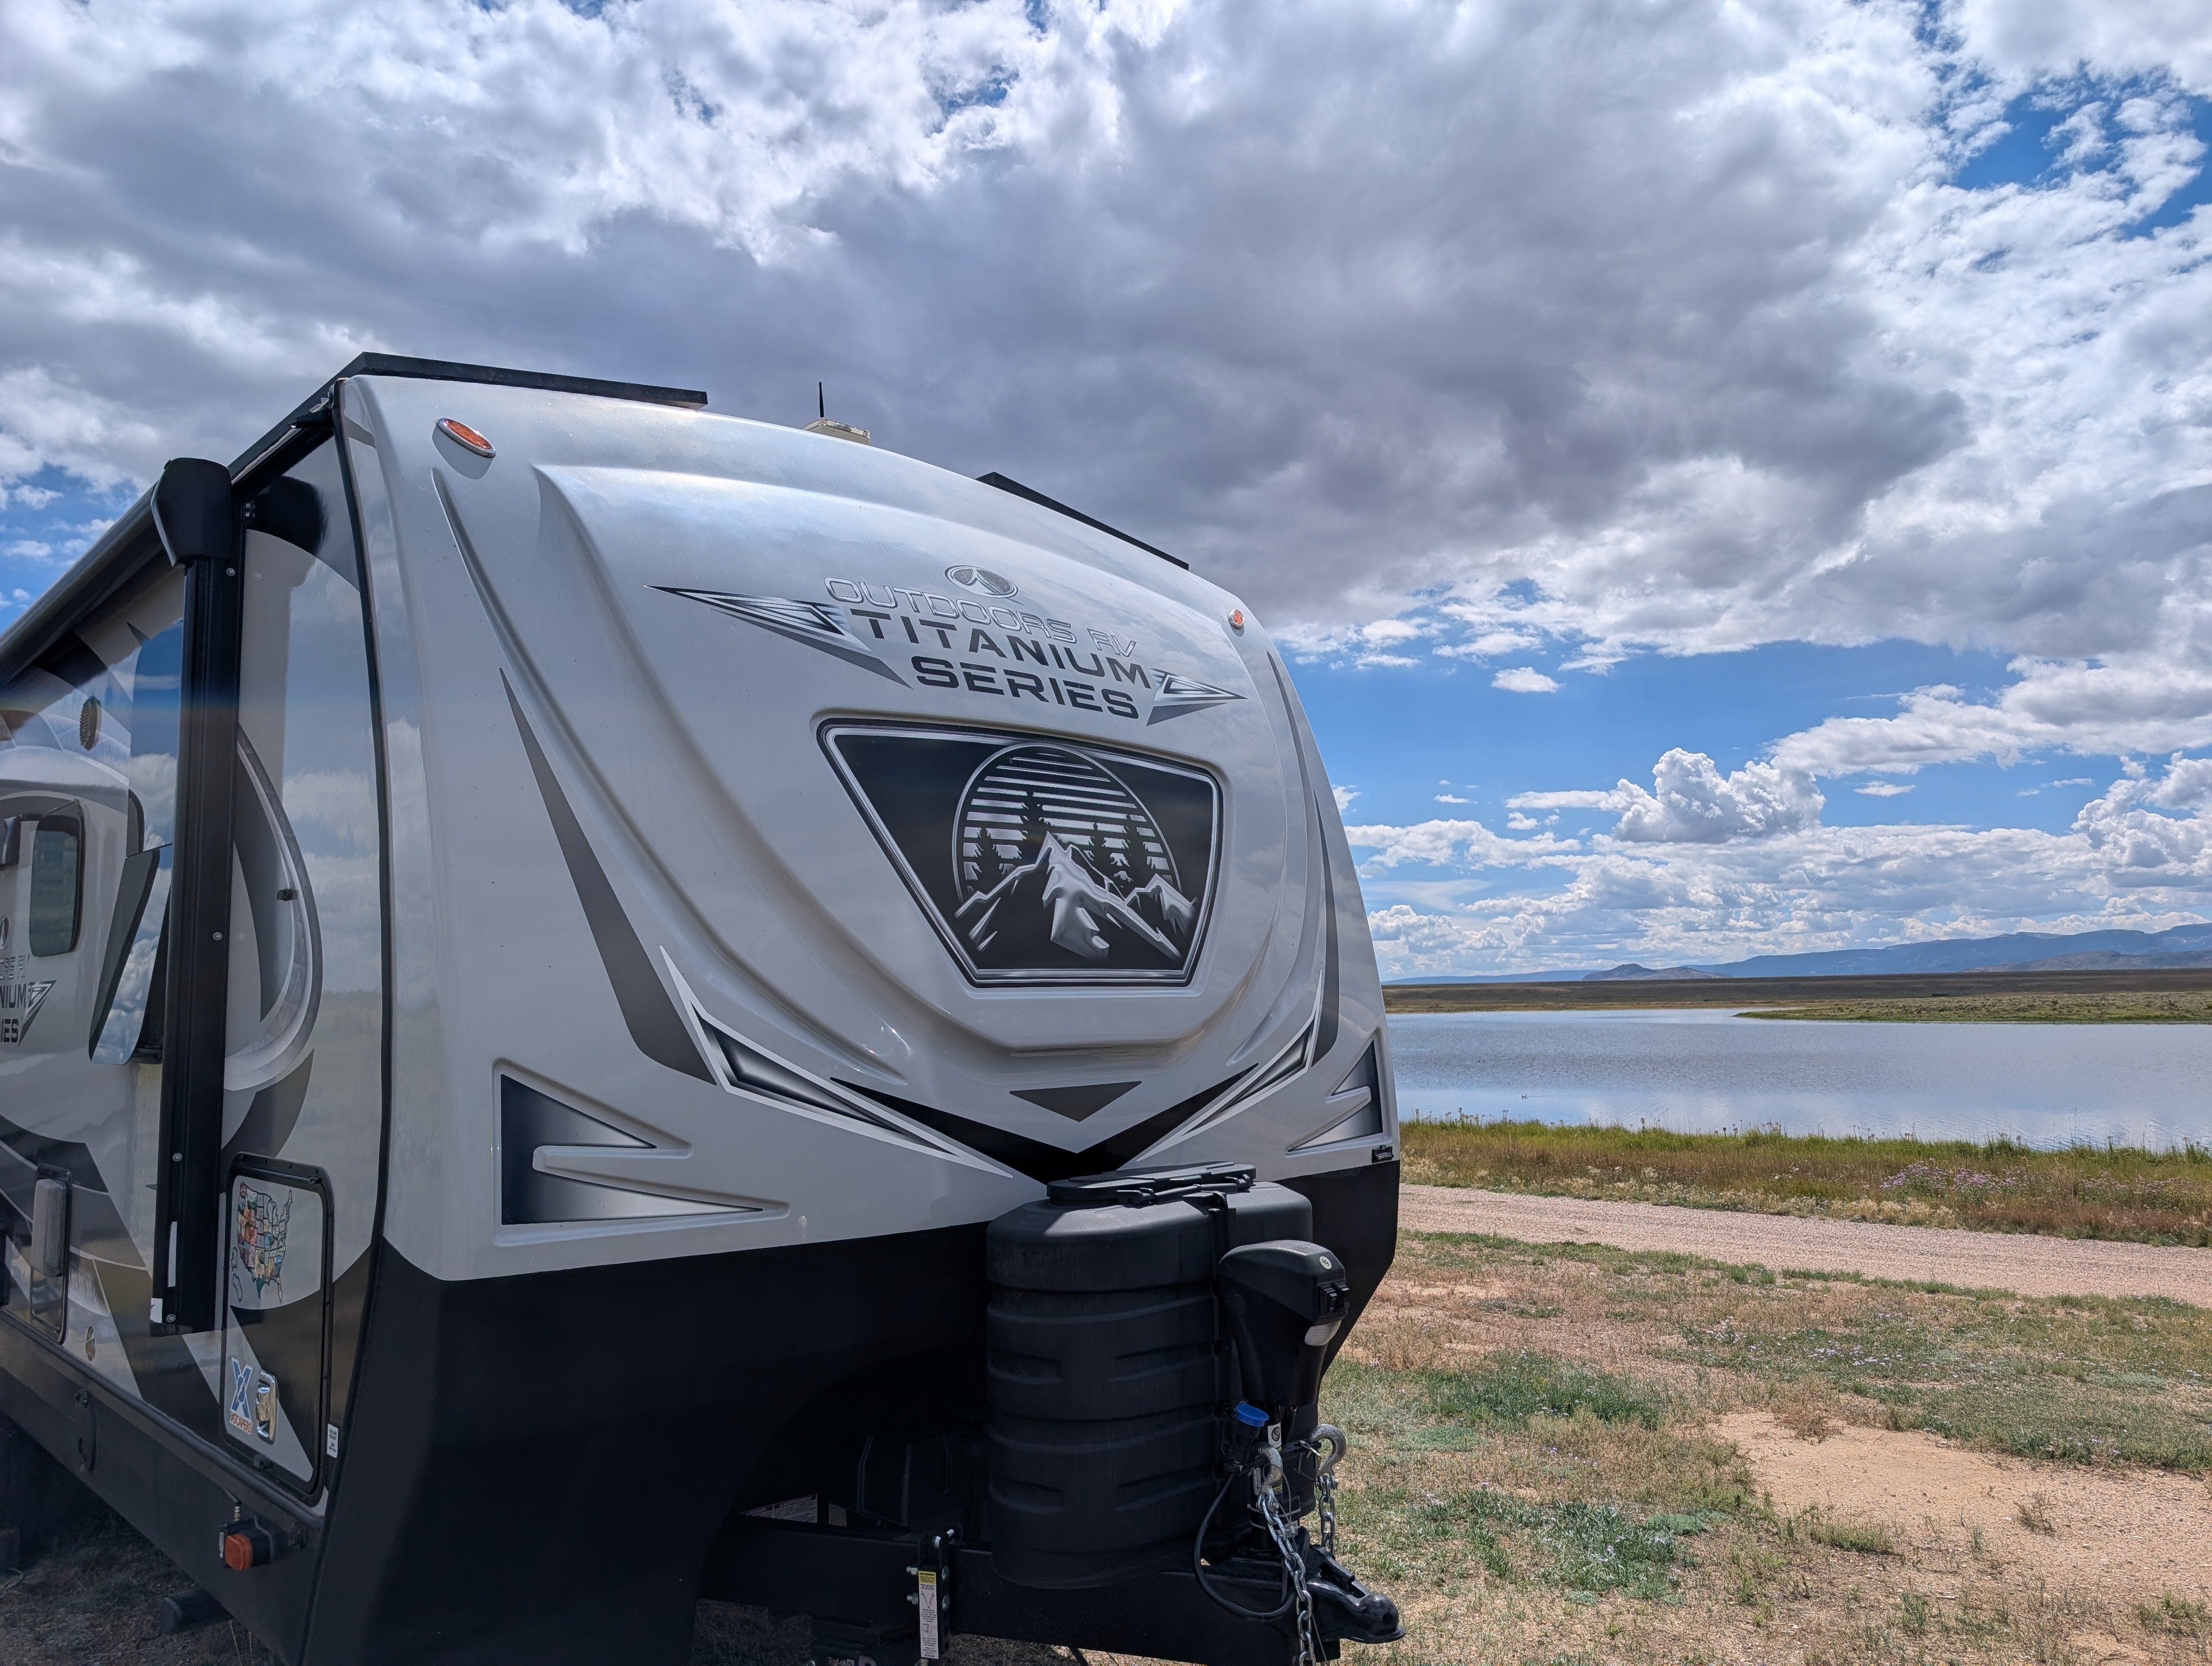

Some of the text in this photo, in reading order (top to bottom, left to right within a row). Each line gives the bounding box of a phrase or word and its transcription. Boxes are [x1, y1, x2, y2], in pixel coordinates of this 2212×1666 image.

[824, 576, 1136, 657] OUTDOORS RV
[850, 608, 1151, 689] TITANIUM
[911, 656, 1139, 719] SERIES
[230, 1410, 252, 1433] XSCAPERS
